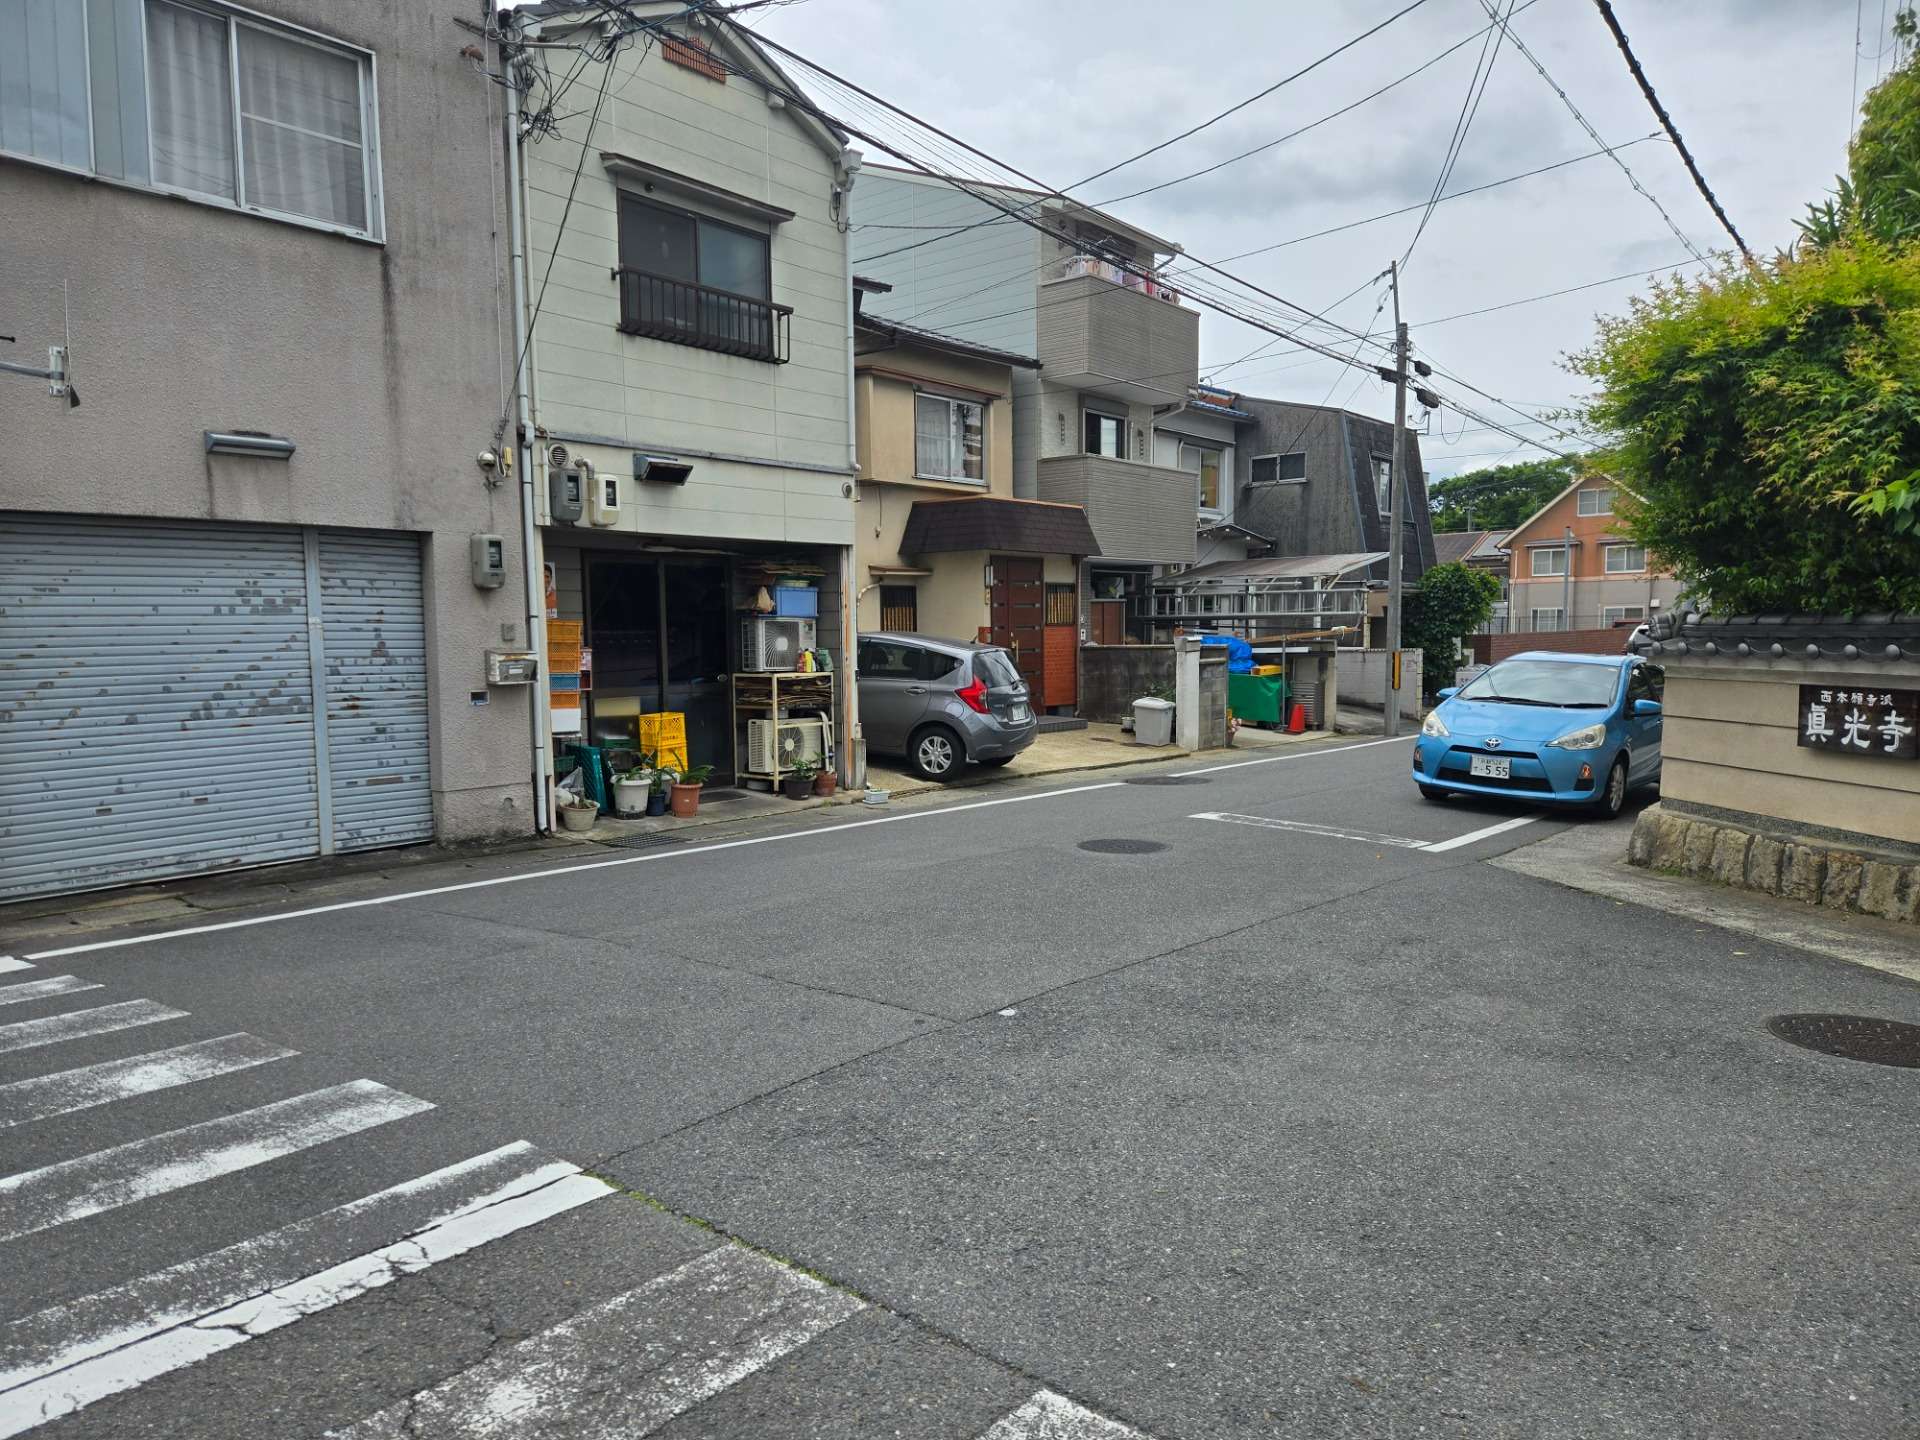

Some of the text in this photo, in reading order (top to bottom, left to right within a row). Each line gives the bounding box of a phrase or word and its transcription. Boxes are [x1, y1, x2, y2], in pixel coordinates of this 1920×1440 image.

[1820, 690, 1894, 706] 西本願寺派
